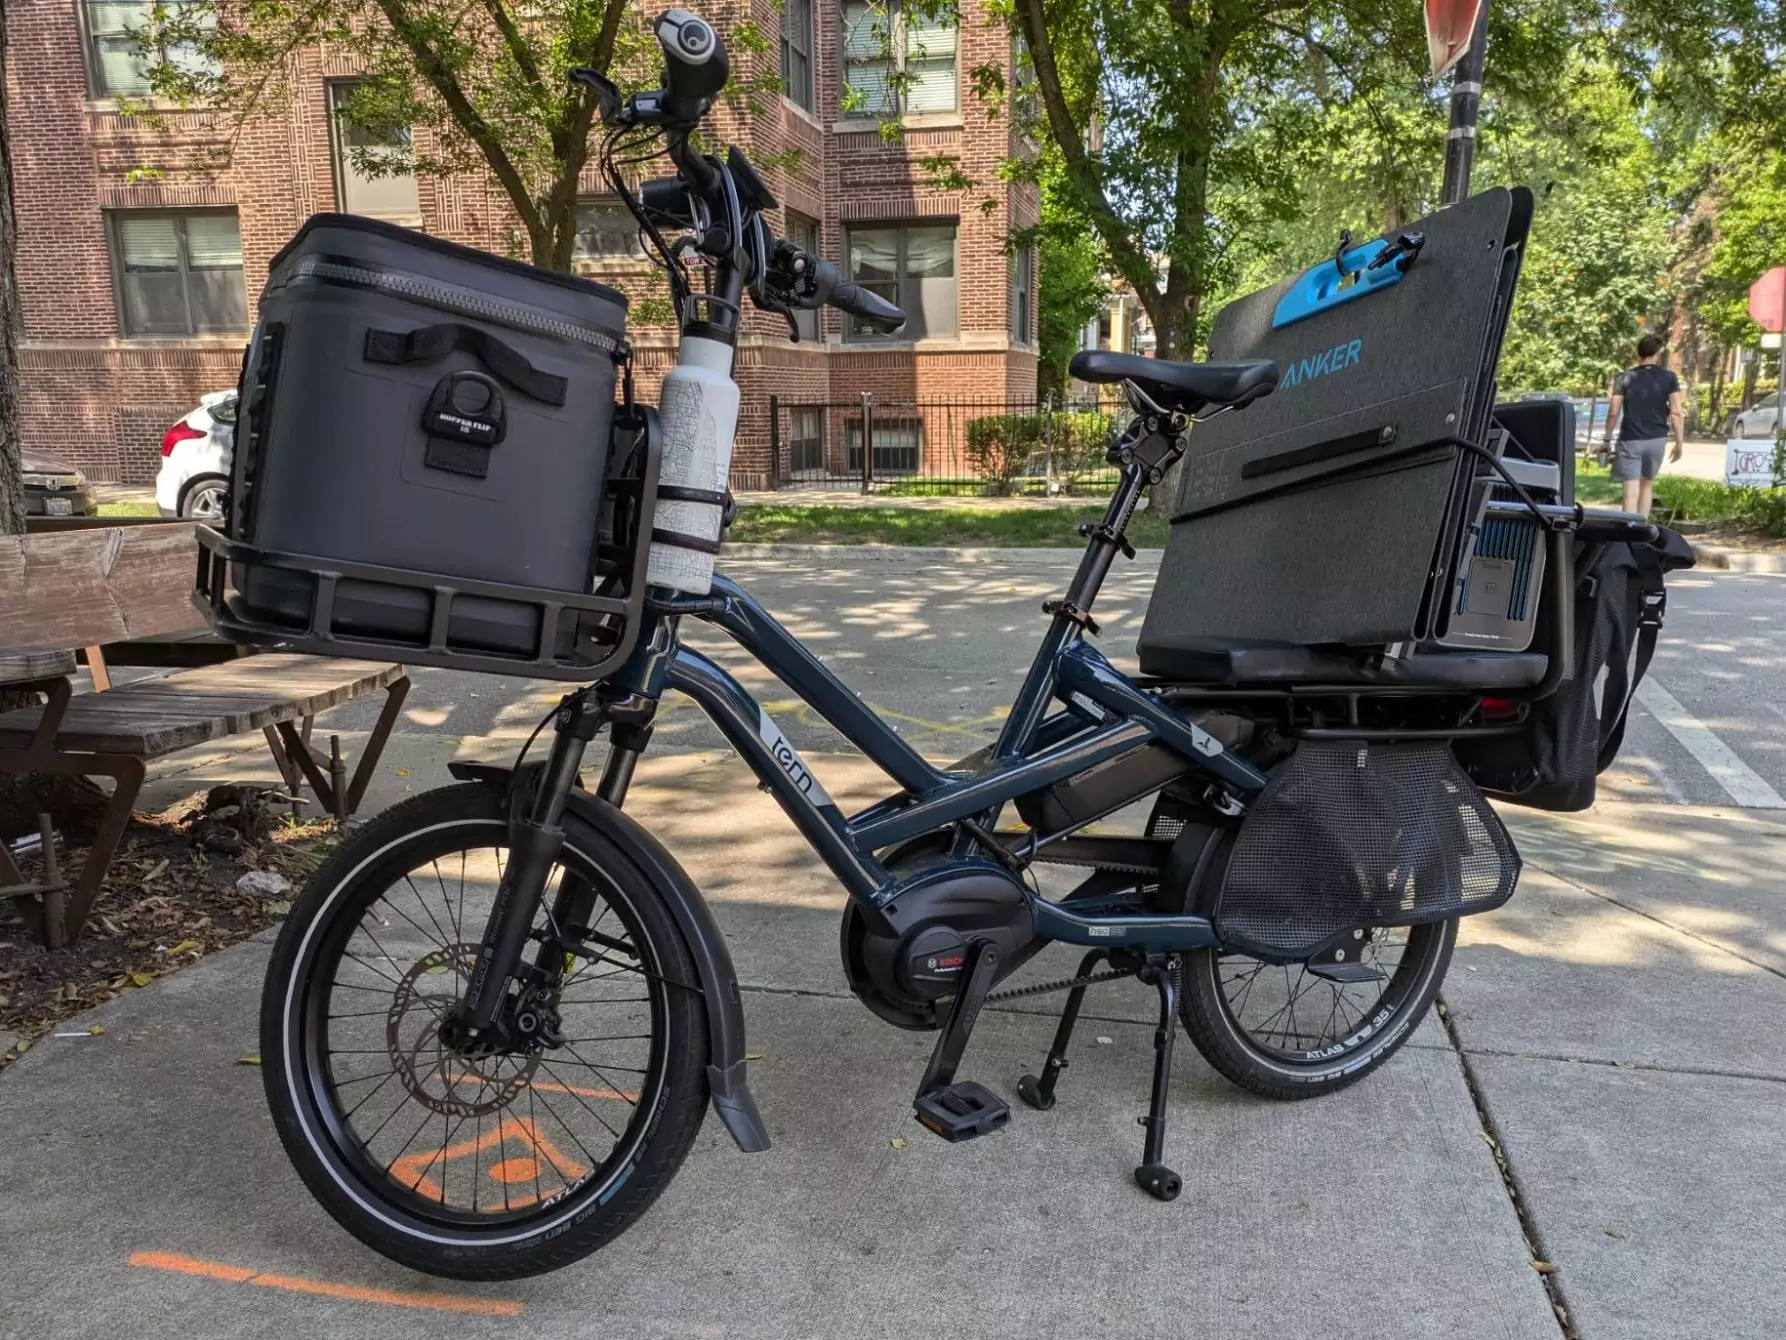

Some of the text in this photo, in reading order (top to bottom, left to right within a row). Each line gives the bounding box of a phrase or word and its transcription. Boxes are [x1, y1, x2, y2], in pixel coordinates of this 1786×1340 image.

[1280, 337, 1363, 391] ANKER
[440, 413, 491, 431] HOPPER FLIP
[772, 736, 813, 793] tern
[939, 956, 964, 966] BOSCH
[1306, 1043, 1344, 1059] ATLAS
